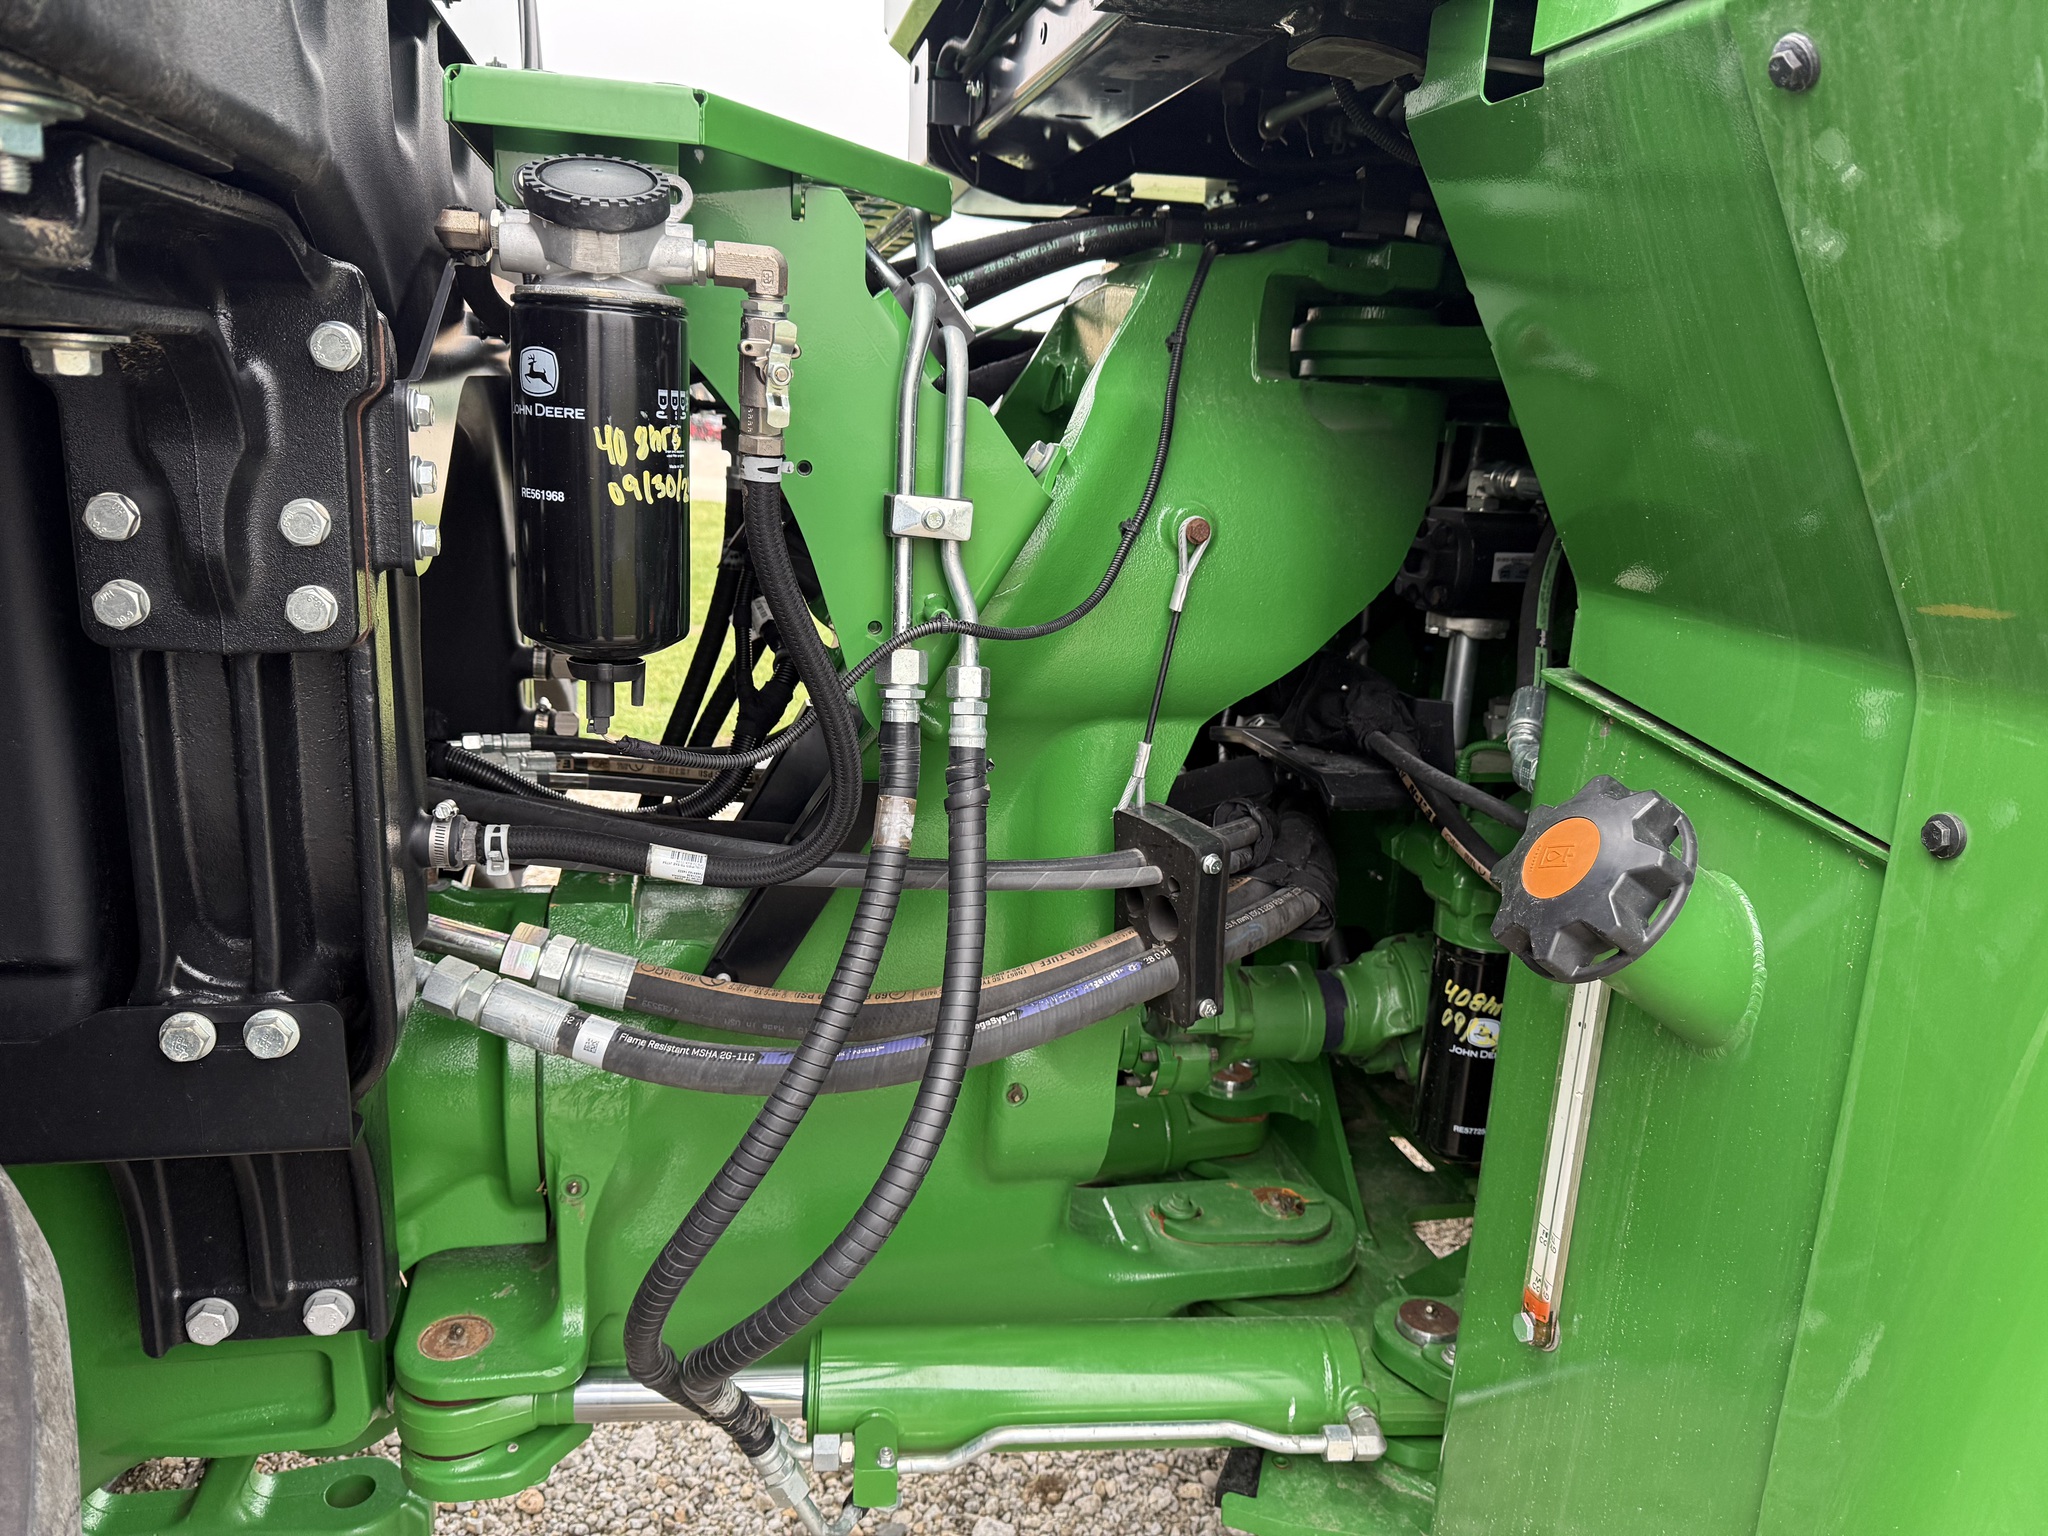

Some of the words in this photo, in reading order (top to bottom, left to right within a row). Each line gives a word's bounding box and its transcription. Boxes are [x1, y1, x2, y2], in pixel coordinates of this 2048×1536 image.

[1107, 221, 1139, 234] Made
[534, 403, 586, 420] DEERE
[521, 486, 565, 503] RE561968
[608, 468, 690, 507] 09/30/2
[1039, 941, 1099, 969] DURA-TUFF
[618, 1032, 646, 1049] Flame
[647, 1038, 691, 1057] Resistant
[690, 1047, 718, 1060] MSHA
[1448, 1043, 1479, 1059] JOHN
